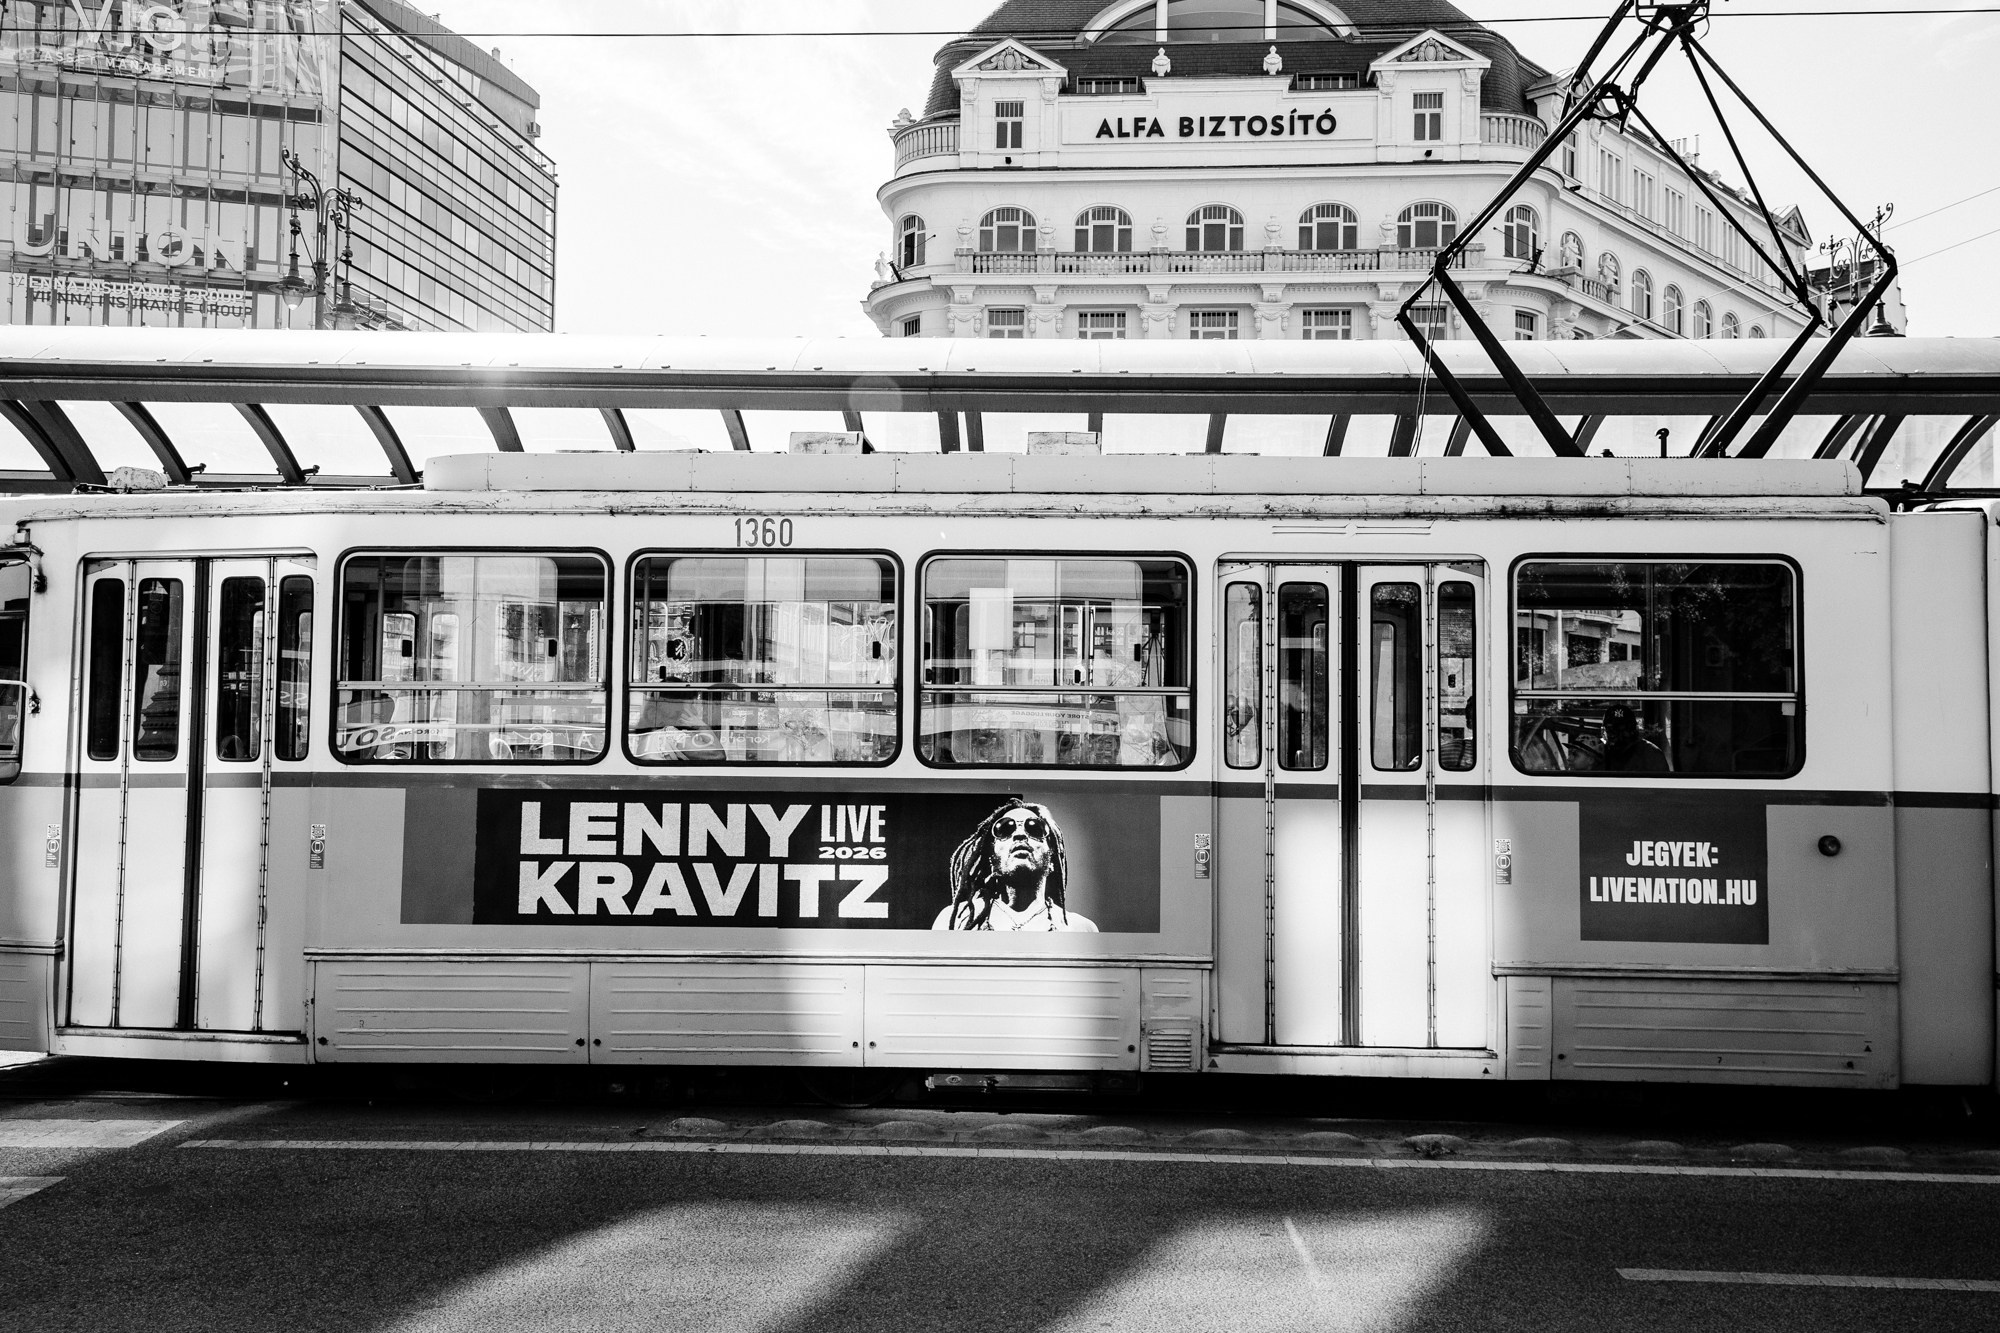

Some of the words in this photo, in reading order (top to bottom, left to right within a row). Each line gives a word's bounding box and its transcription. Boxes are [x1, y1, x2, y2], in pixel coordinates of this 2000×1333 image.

[71, 0, 188, 51] VIG
[44, 51, 97, 66] ASSET
[105, 56, 217, 79] MANAGEMENT
[1096, 116, 1165, 139] ALFA
[1178, 107, 1337, 138] BIZTOSÍTÓ
[12, 212, 248, 272] UNION
[12, 275, 83, 294] VIENNA
[84, 279, 182, 299] INSURANCE
[187, 287, 244, 303] GROUP
[735, 517, 793, 548] 1360
[519, 801, 813, 858] LENNY
[820, 804, 887, 843] LIVE
[818, 846, 887, 860] 2026
[1625, 840, 1720, 868] JEGYEK:
[517, 860, 890, 919] KRAVITZ
[1589, 876, 1758, 906] LIVENATION.HU
